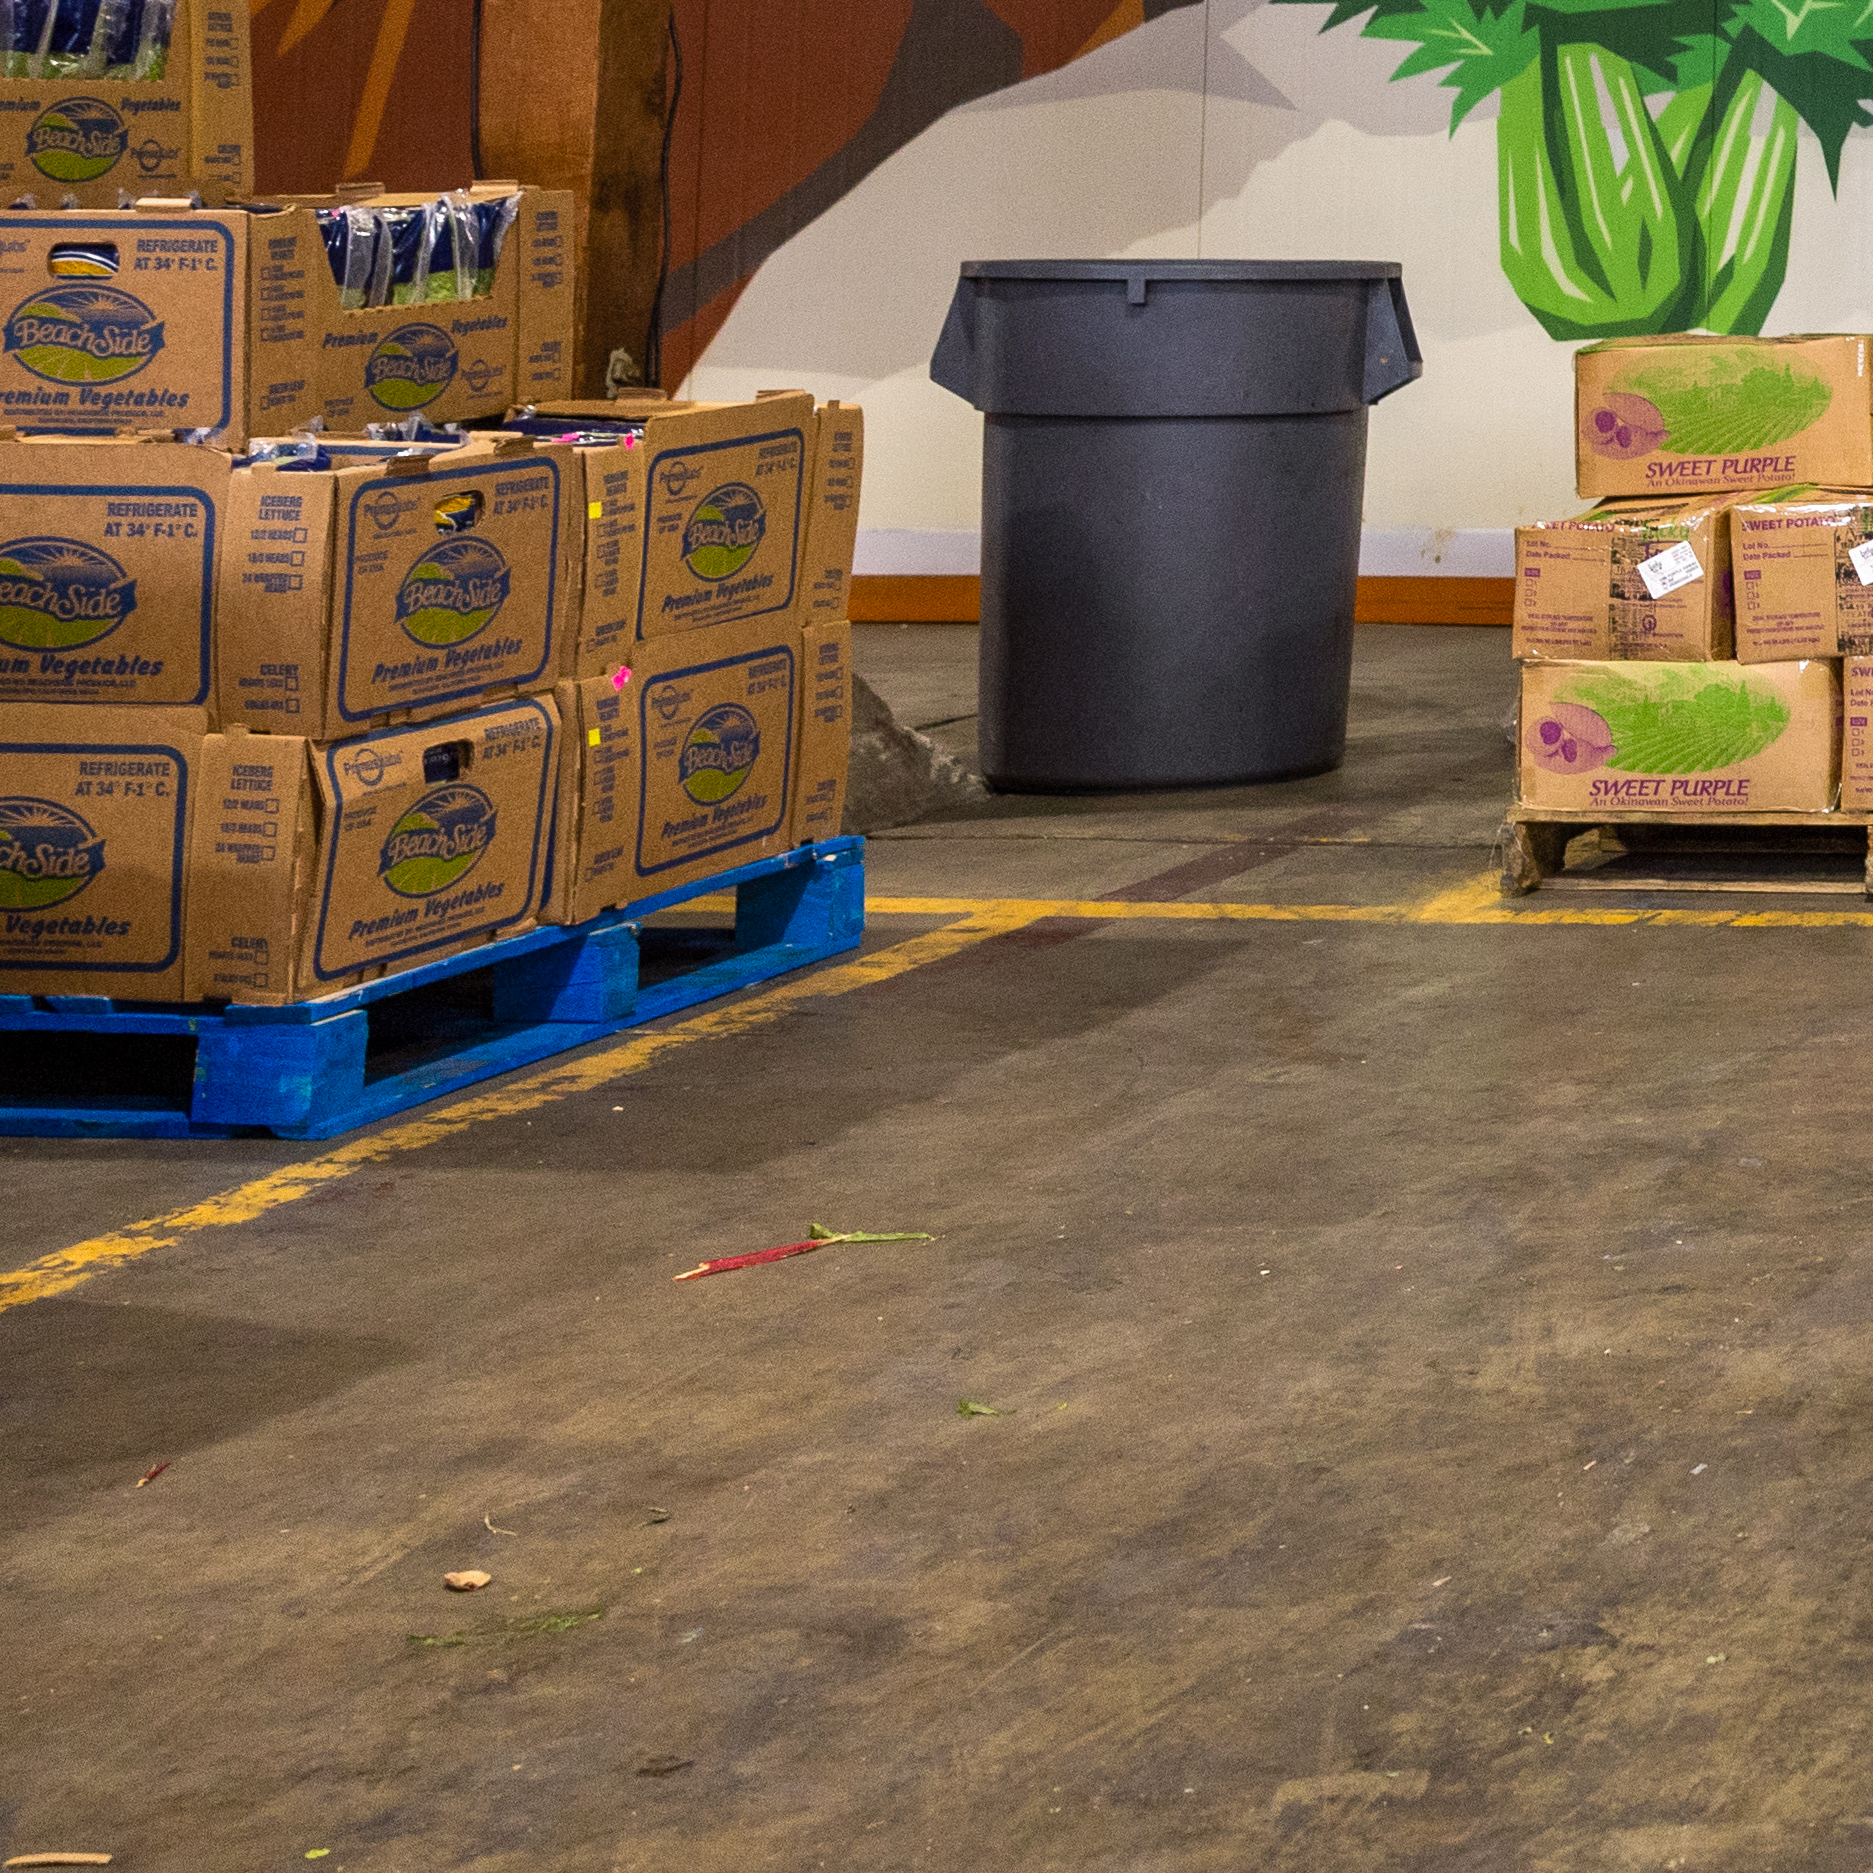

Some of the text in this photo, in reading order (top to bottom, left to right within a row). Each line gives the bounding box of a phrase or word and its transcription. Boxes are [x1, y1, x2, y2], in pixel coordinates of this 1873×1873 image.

[136, 239, 218, 253] REFRIGERATE
[133, 257, 152, 271] AT
[0, 388, 190, 410] remium Vegetables
[1644, 455, 1796, 479] SWEET PURPLE
[1647, 476, 1662, 487] An
[1723, 474, 1752, 485] Sweet
[107, 502, 198, 517] REFRIGERATE
[1742, 519, 1782, 531] SWEET
[39, 654, 163, 676] Vegetables
[371, 652, 439, 684] Premium
[79, 760, 170, 776] REFRIGERATE
[1589, 778, 1750, 798] SWEET PURPLE
[1590, 796, 1605, 807] An
[1609, 796, 1668, 807] Okinawan
[1671, 796, 1704, 807] Sweet
[348, 881, 506, 940] Premium Vegetables
[6, 915, 132, 936] Vegetables
